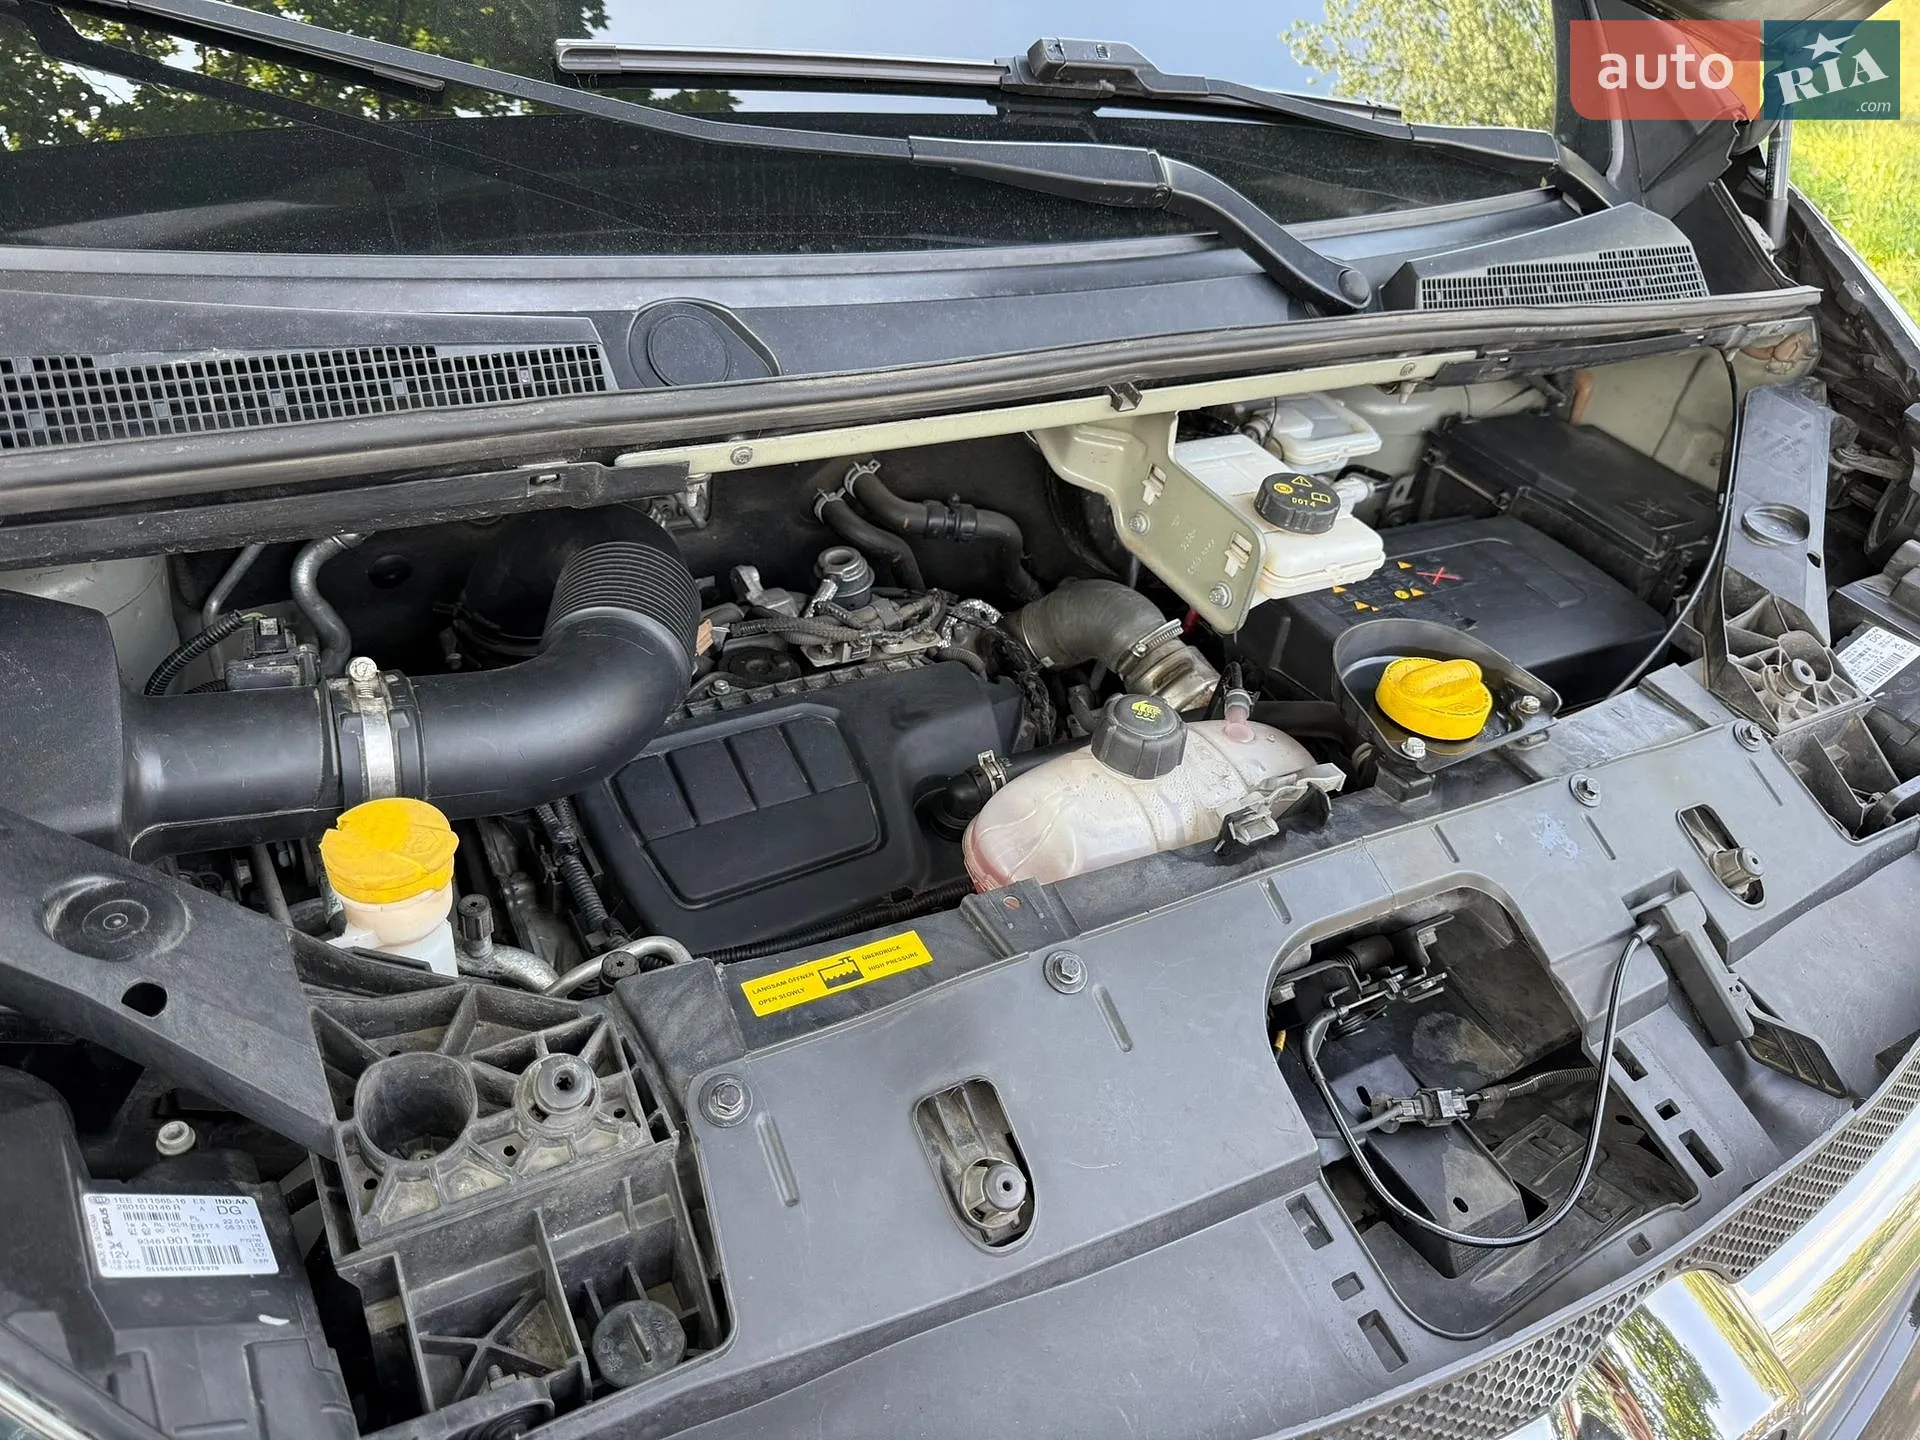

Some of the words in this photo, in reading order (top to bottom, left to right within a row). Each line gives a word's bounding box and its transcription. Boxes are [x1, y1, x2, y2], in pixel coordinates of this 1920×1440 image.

[1291, 497, 1308, 506] DOT
[861, 944, 902, 961] ÜBERDRUCK
[868, 961, 885, 972] HIGH
[885, 951, 919, 967] PRESSURE
[752, 979, 787, 995] LANGSAM
[787, 971, 815, 984] ÖFFNEN
[758, 995, 778, 1006] OPEN
[778, 987, 806, 1000] SLOWLY
[216, 1205, 242, 1215] DG
